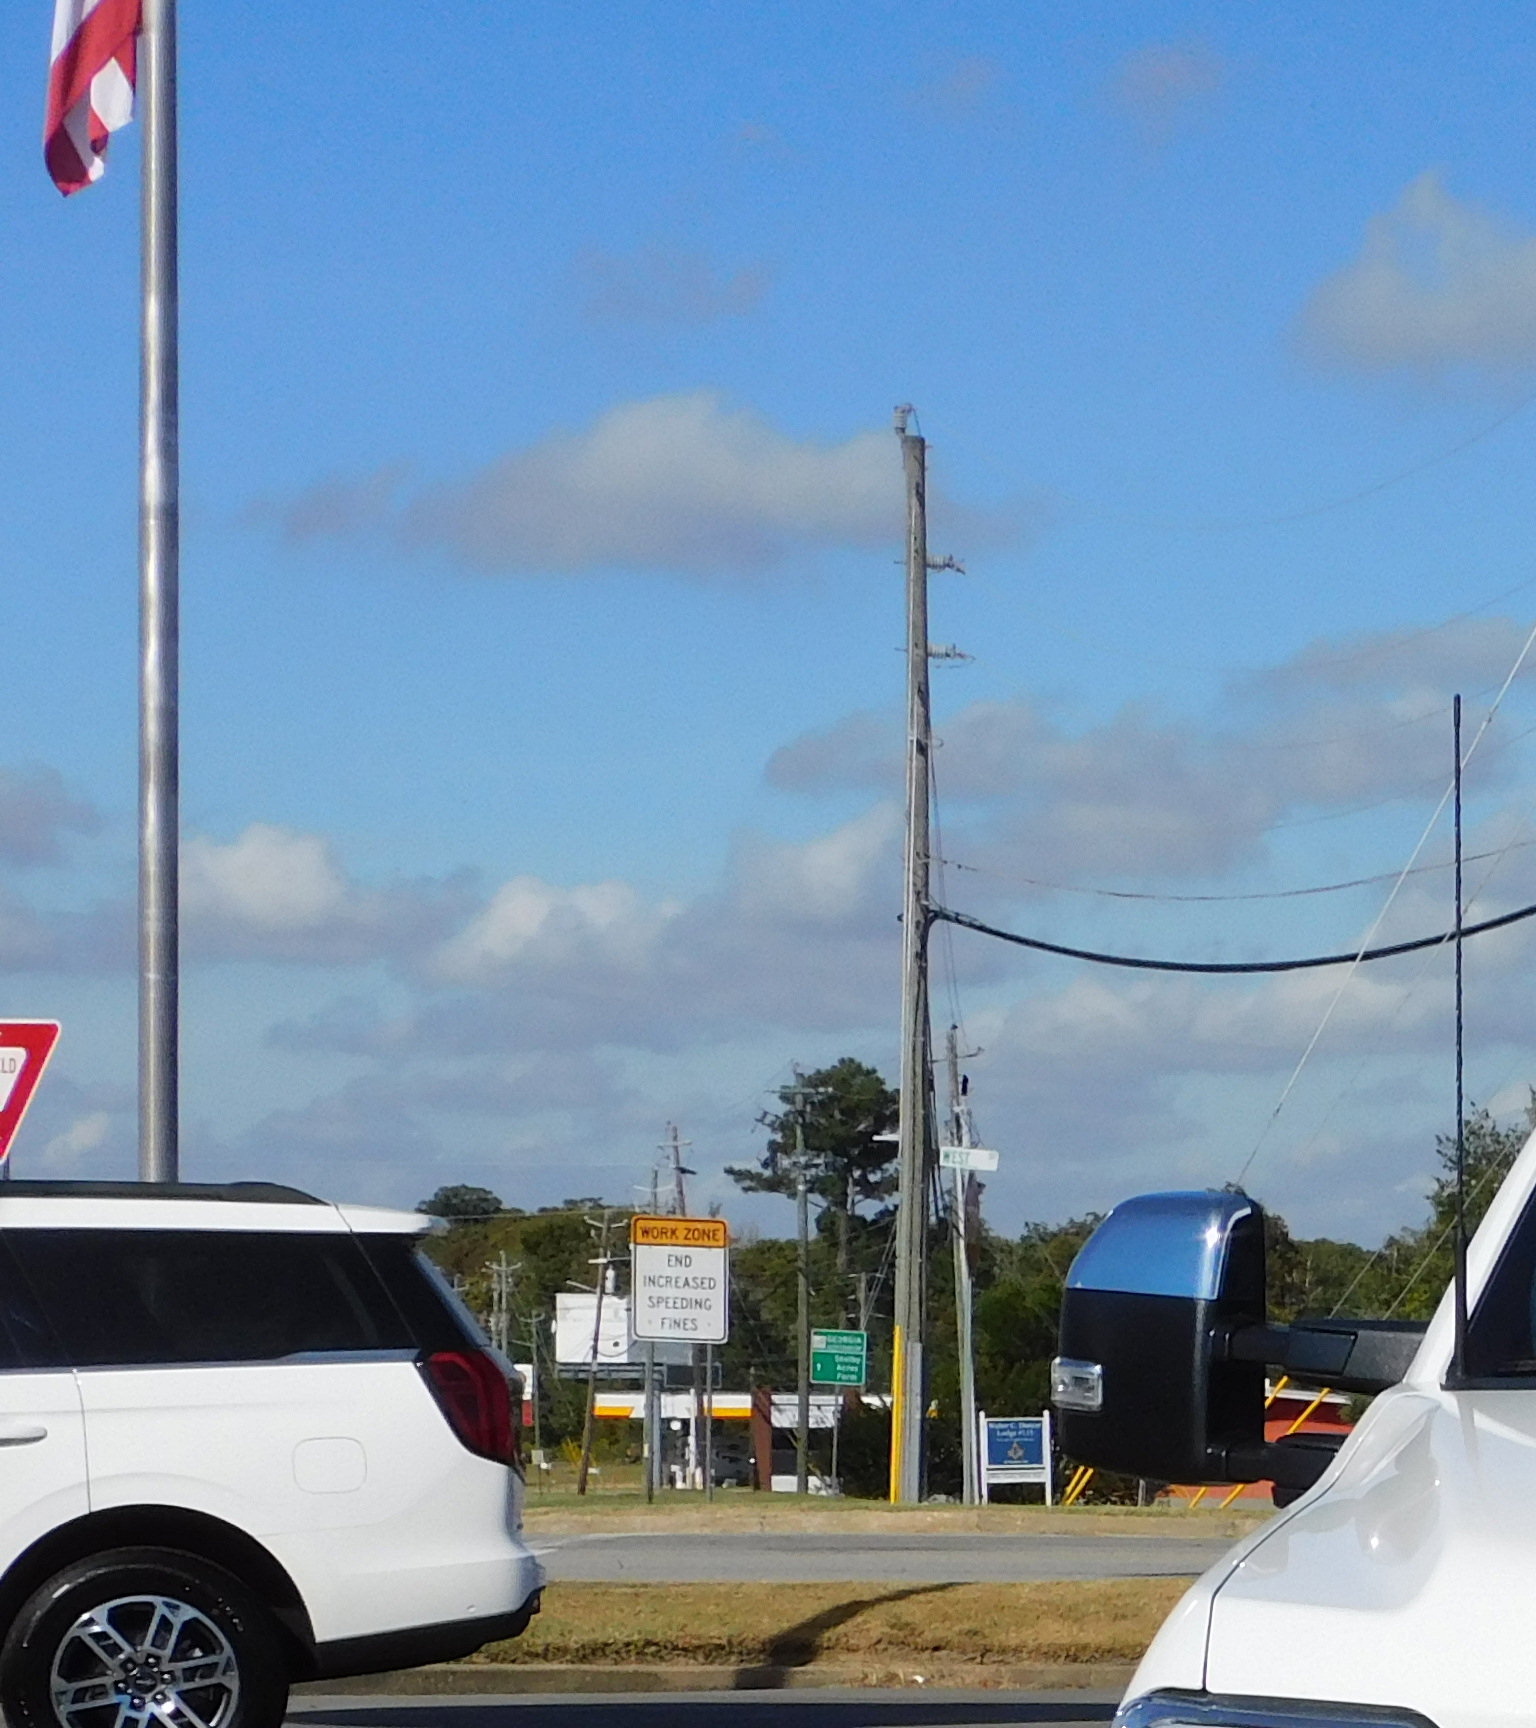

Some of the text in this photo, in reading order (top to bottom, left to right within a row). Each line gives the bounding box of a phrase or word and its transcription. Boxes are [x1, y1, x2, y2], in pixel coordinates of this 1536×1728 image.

[640, 1226, 720, 1242] WORK ZONE
[667, 1253, 692, 1268] END
[643, 1275, 717, 1290] INCREASED
[648, 1296, 712, 1311] SPEEDING
[660, 1317, 698, 1331] FINES
